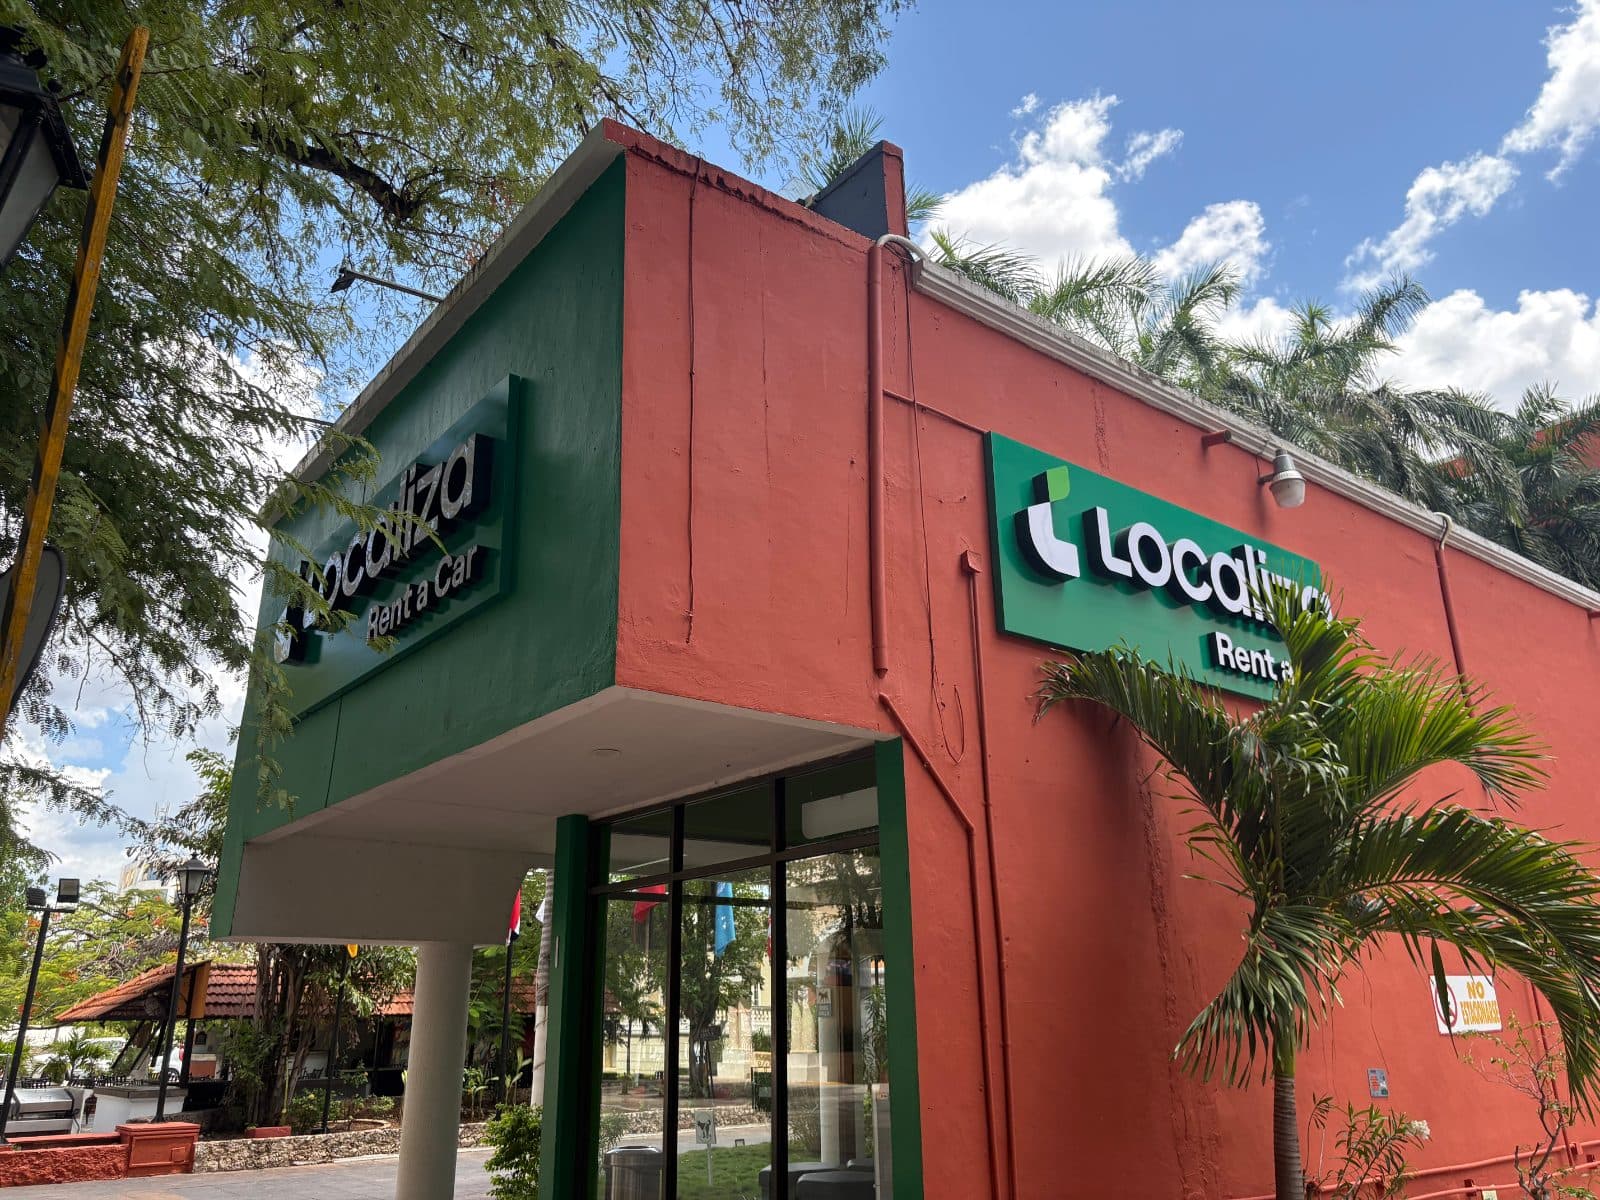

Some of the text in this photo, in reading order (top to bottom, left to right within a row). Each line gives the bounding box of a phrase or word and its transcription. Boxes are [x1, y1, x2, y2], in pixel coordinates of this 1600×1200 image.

[366, 544, 478, 641] Rent a Car
[1215, 631, 1278, 681] Rent
[1466, 981, 1485, 999] NO
